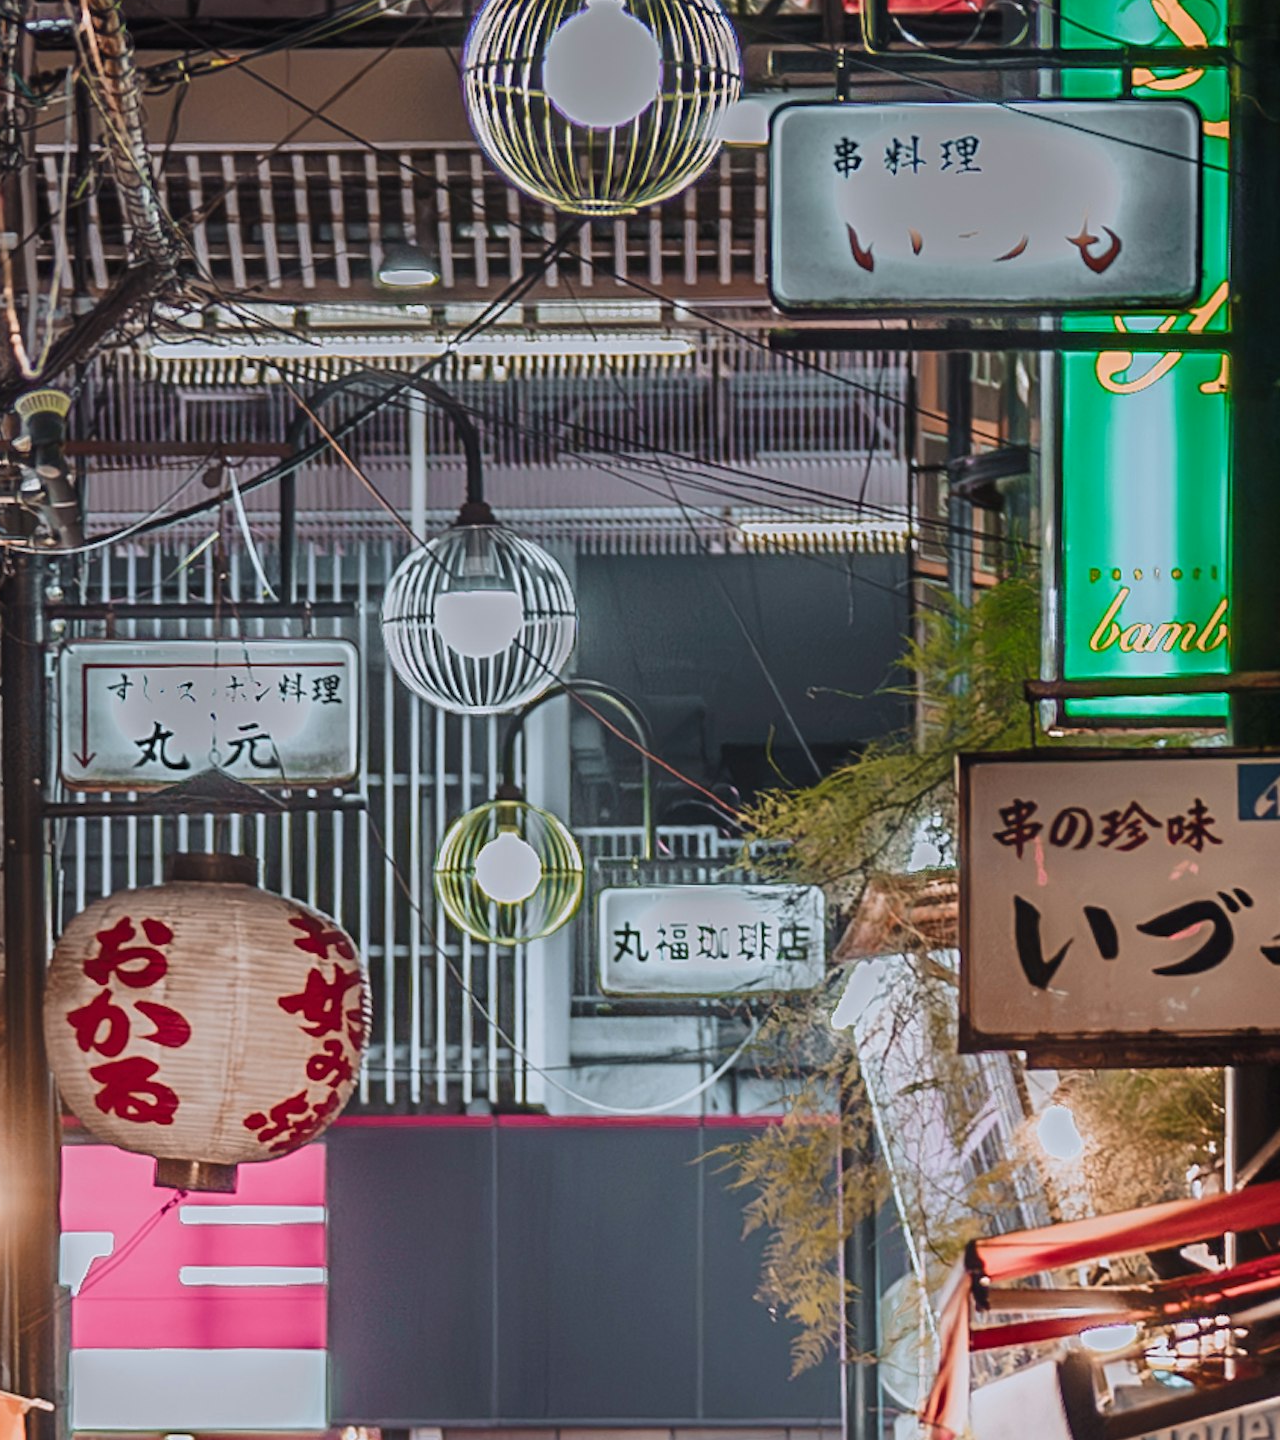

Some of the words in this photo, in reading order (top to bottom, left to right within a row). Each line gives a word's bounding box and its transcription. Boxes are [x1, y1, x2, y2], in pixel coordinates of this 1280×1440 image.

[831, 136, 983, 176] 串料理
[132, 721, 281, 770] 丸元
[992, 797, 1223, 859] 串の珍味
[613, 920, 811, 962] 丸福珈琲店
[66, 915, 192, 1126] おかる
